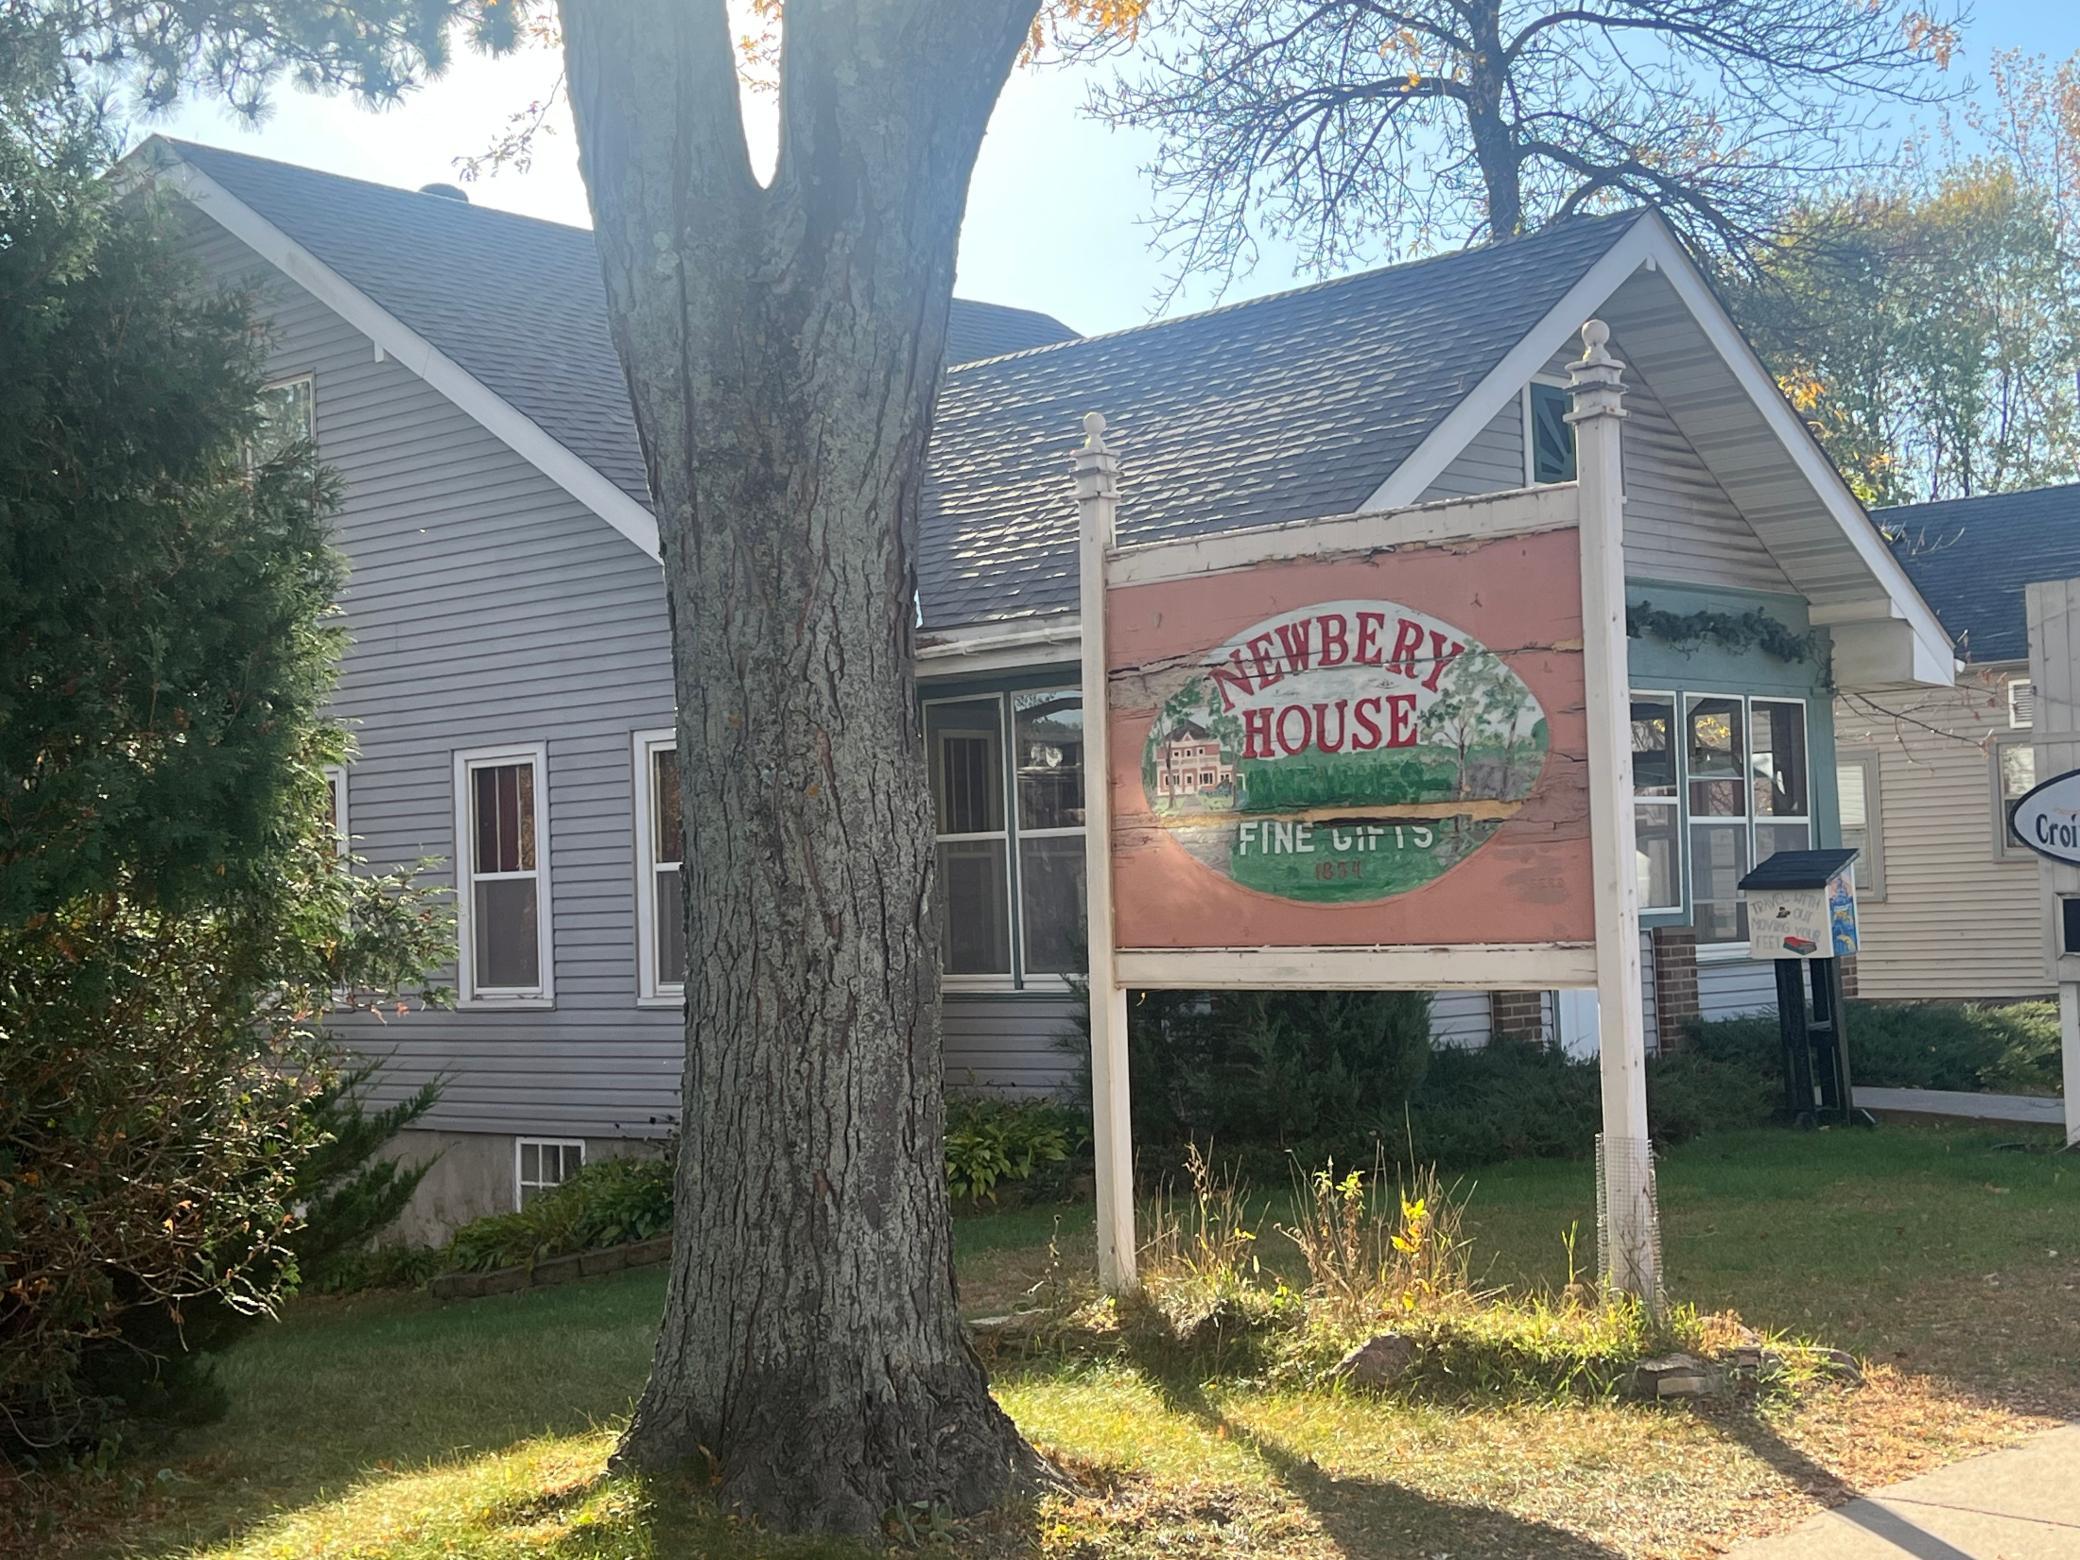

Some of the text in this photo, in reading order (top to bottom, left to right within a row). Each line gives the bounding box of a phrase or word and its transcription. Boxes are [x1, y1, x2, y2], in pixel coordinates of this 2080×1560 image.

[1208, 611, 1466, 714] NEWBERY
[1241, 694, 1418, 760] HOUSE
[1239, 820, 1315, 856] FINE
[2035, 813, 2080, 848] Croi
[1750, 891, 1789, 915] TRAVEL
[1793, 907, 1813, 923] OUT
[1751, 918, 1822, 942] MOVING YOUR
[1756, 935, 1781, 950] FEET
